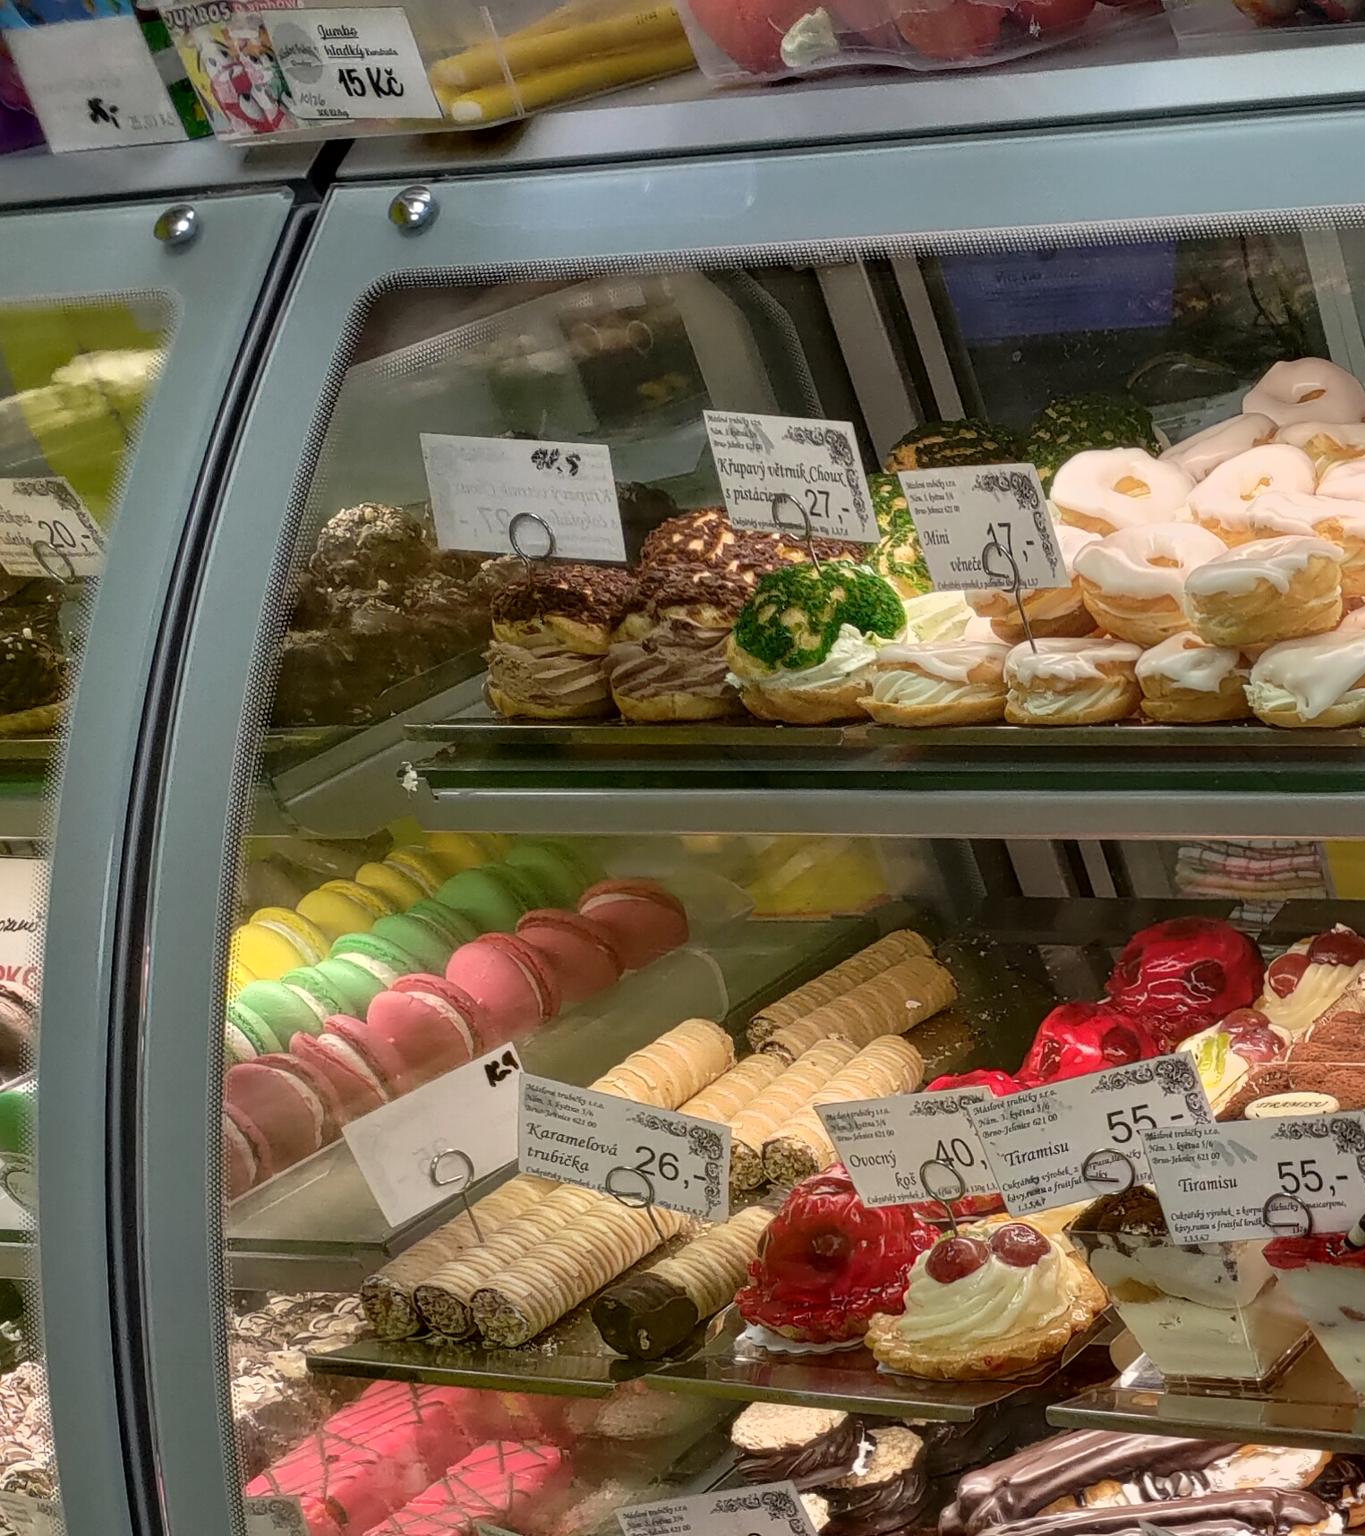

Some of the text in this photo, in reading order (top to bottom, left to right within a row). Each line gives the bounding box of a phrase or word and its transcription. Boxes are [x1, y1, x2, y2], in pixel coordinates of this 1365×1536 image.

[318, 24, 359, 39] Jumbo
[338, 67, 404, 97] 15 Kč
[718, 457, 847, 486] Křupavý větrník Choux
[725, 490, 731, 501] s
[805, 489, 850, 525] 27,-
[39, 520, 91, 551] 20,-
[924, 530, 950, 547] Mini
[987, 522, 1035, 562] 17,-
[1031, 1117, 1046, 1128] 621
[1047, 1113, 1058, 1123] 00
[1036, 1103, 1050, 1115] 5/6
[526, 1122, 617, 1156] Karamelová
[527, 1146, 707, 1188] trubička 26,-
[850, 1151, 896, 1168] Ovocný
[1004, 1141, 1069, 1167] Tiramisu
[896, 1171, 917, 1189] koš
[1178, 1160, 1348, 1196] Tiramisu 55,-
